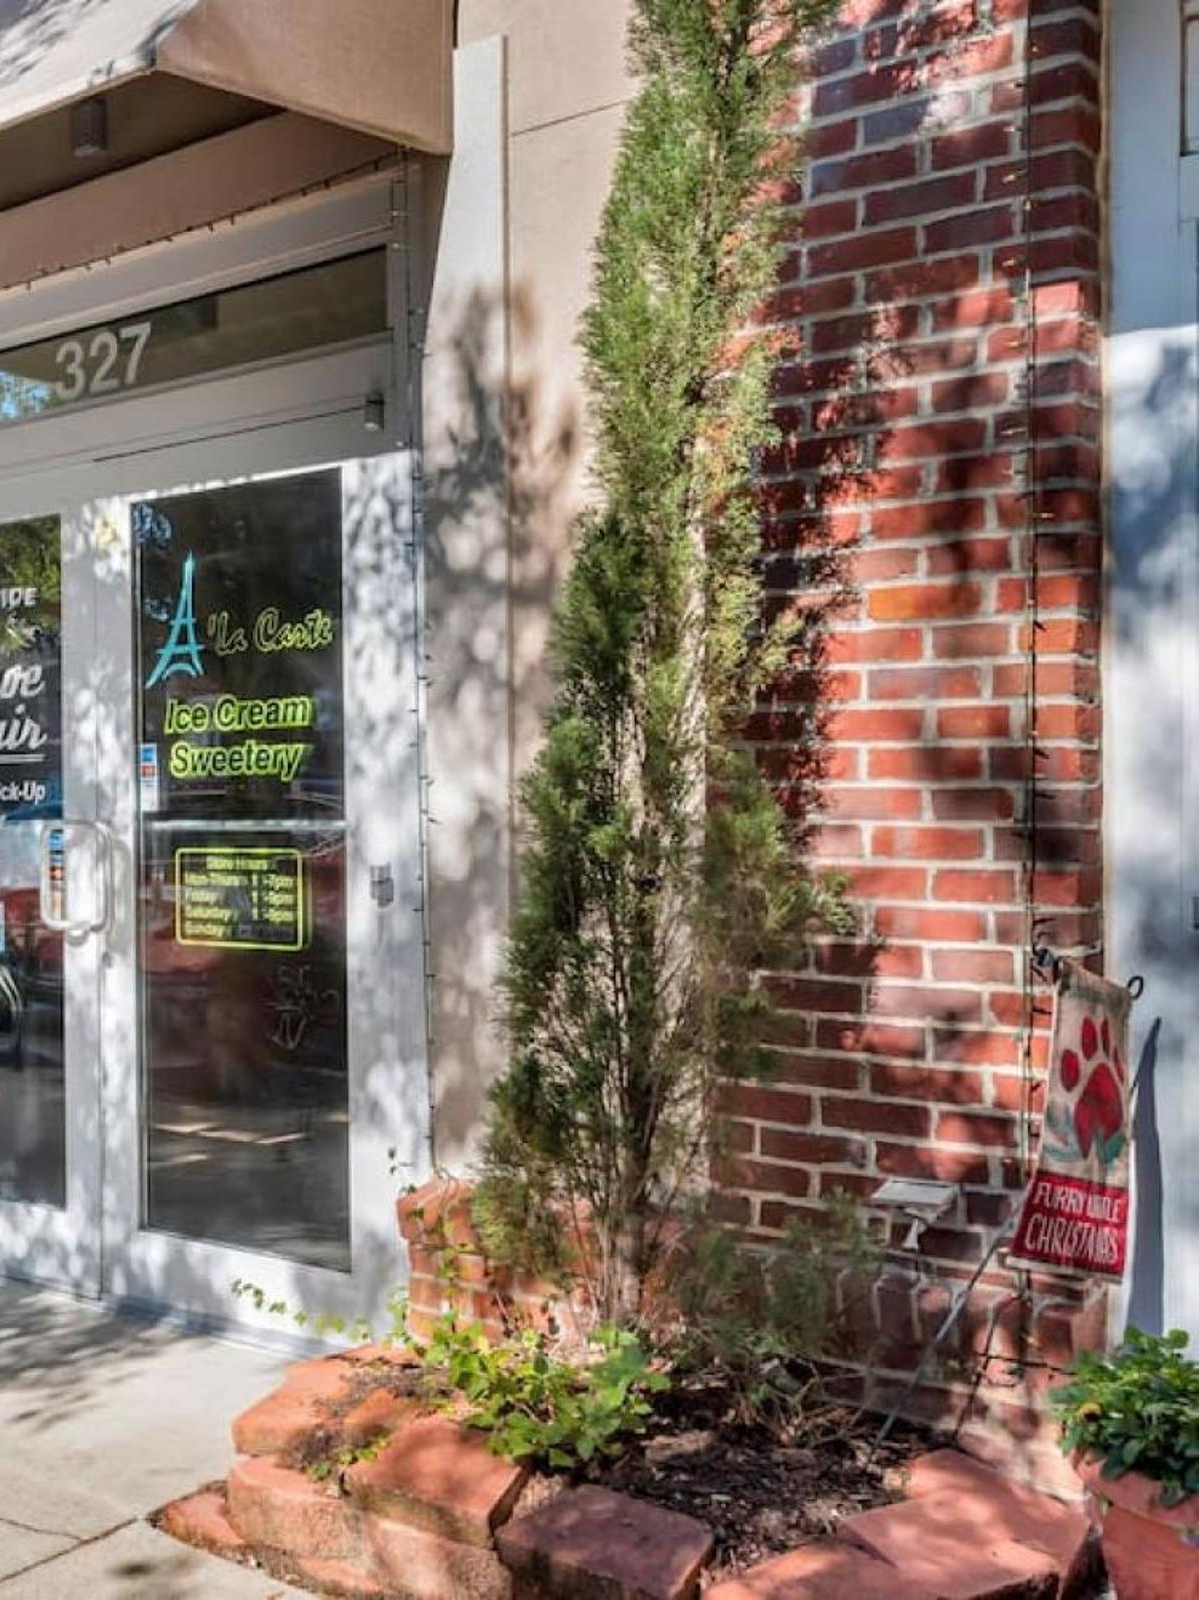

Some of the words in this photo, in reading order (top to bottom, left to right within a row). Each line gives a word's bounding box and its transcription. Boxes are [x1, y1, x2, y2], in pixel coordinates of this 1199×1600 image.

[55, 321, 151, 400] 327
[164, 697, 209, 735] Ice
[214, 693, 314, 732] Cream
[169, 738, 309, 782] Sweetery
[1024, 1212, 1119, 1264] CHRISTMAS
